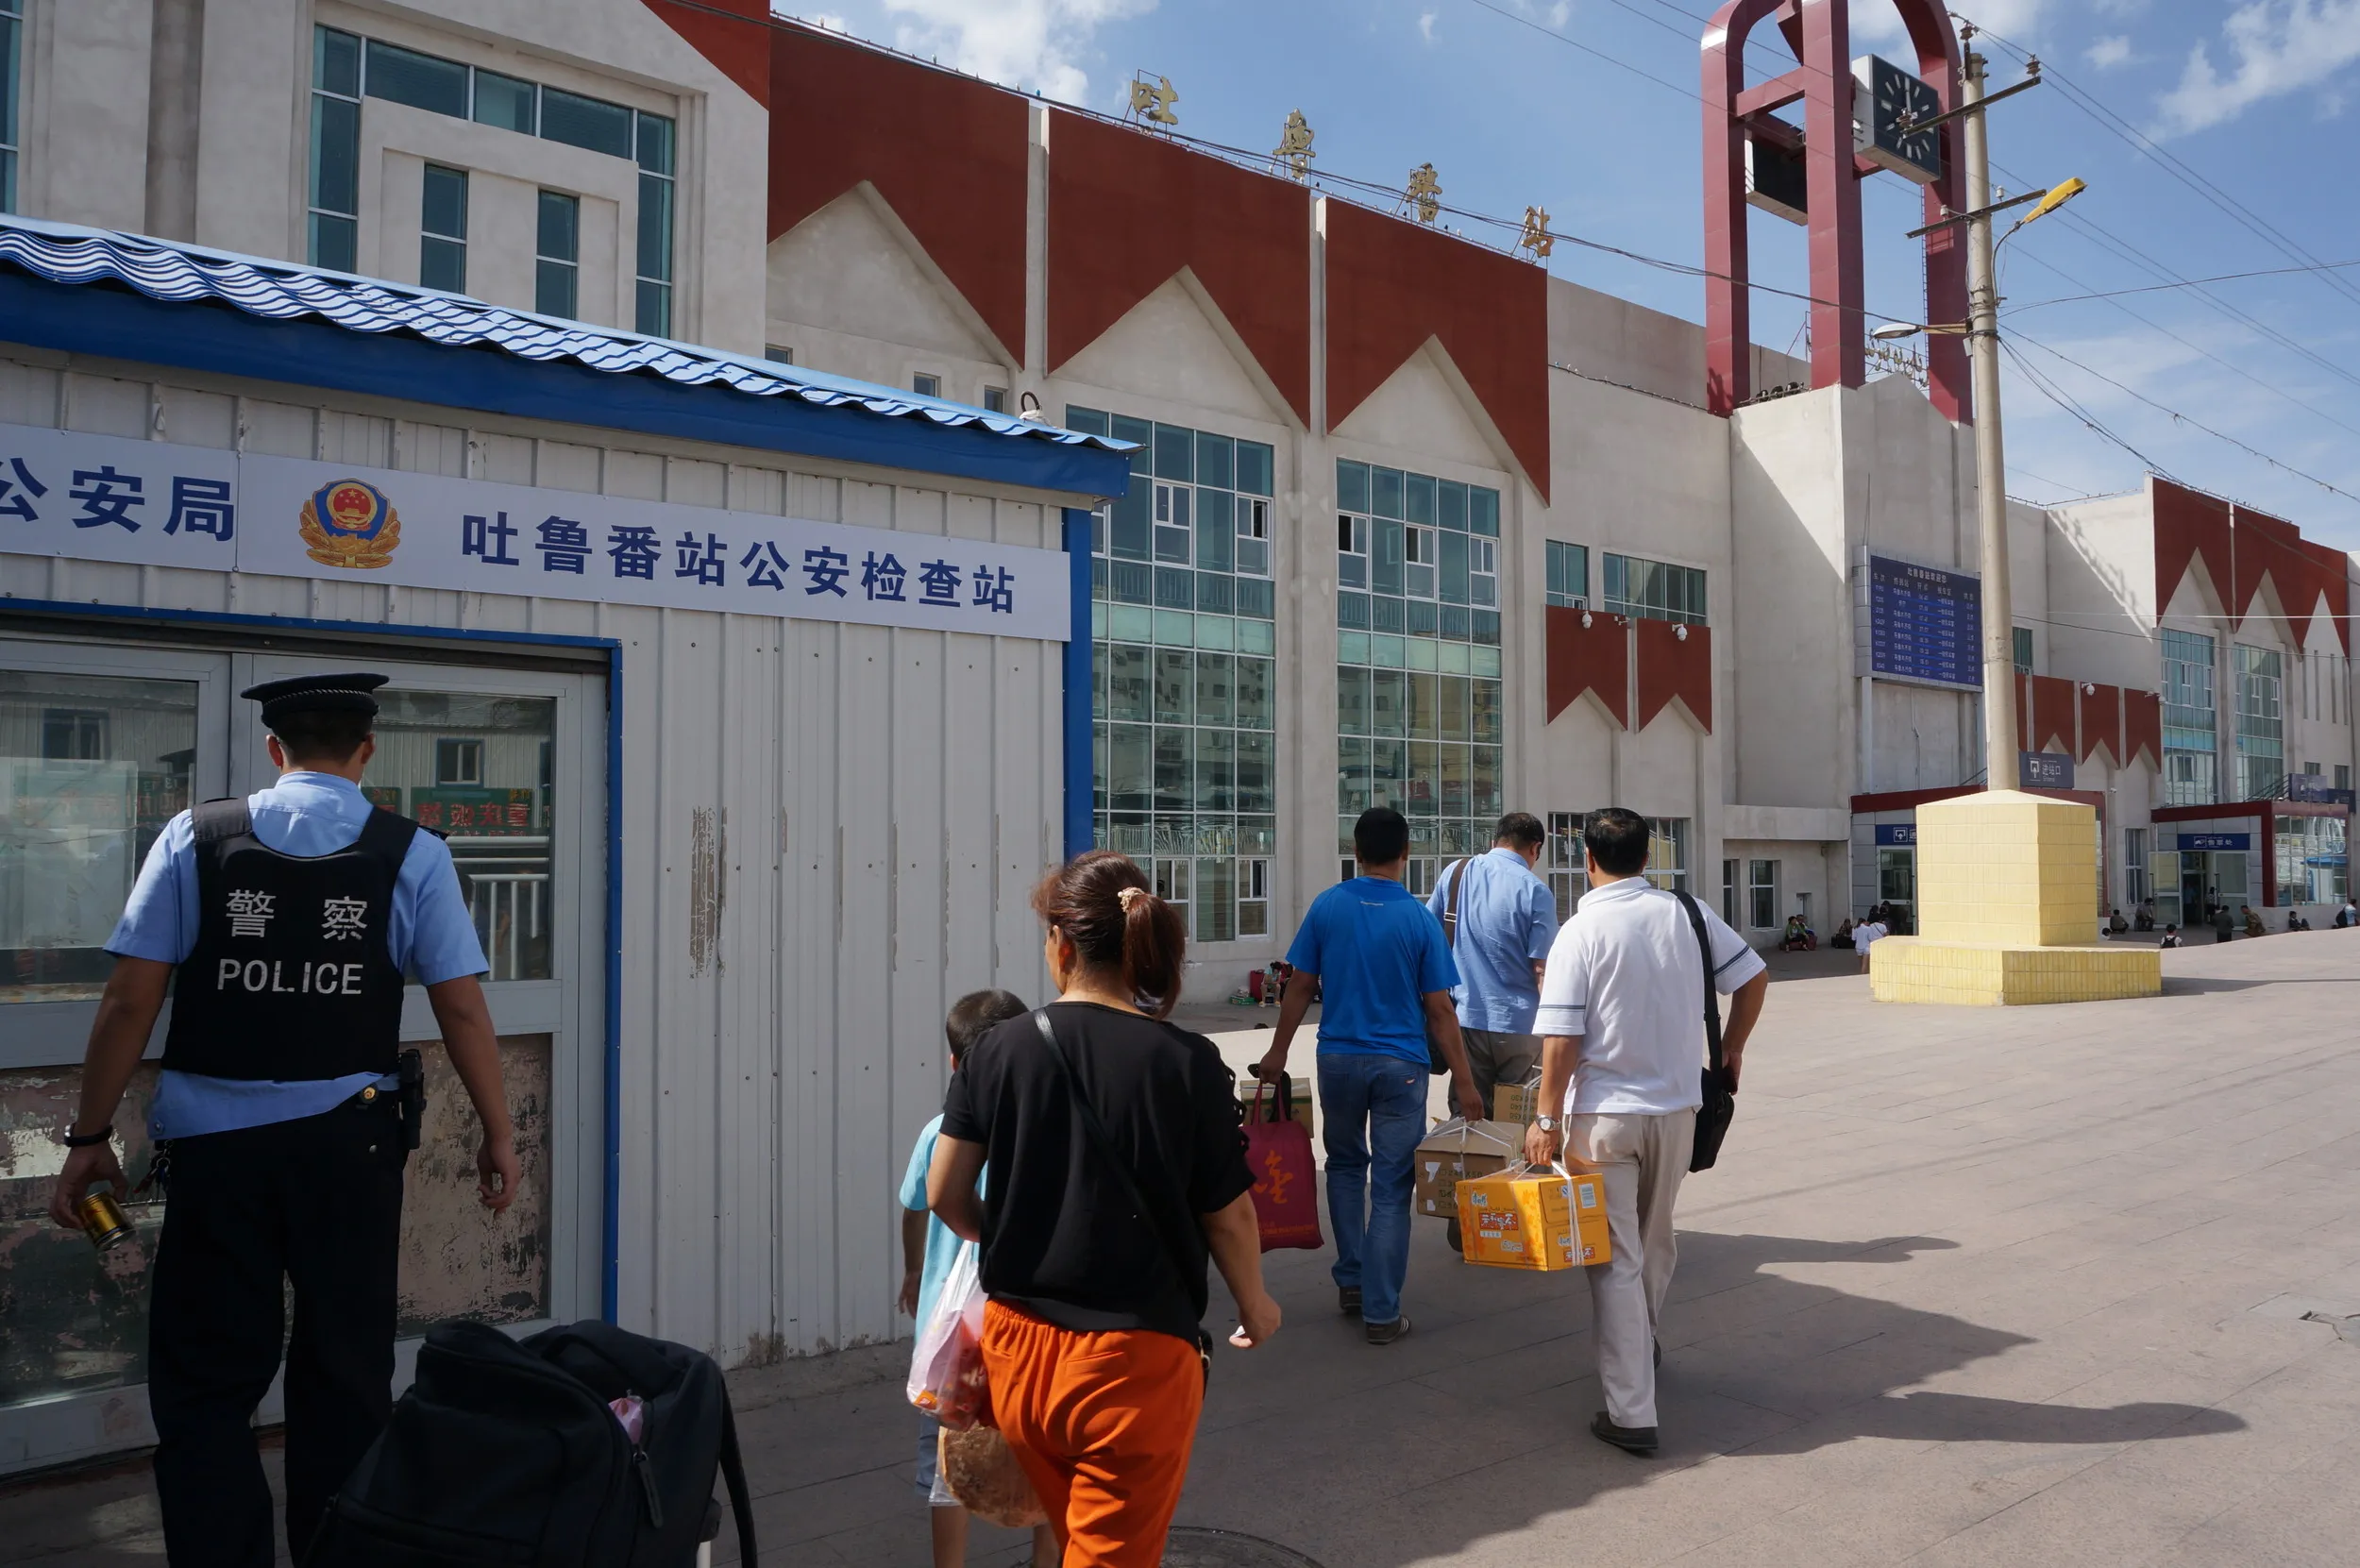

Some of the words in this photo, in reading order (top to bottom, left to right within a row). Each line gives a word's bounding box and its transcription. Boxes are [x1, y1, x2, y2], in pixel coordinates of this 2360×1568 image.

[0, 457, 234, 542] 公安局
[461, 511, 1016, 615] 吐鲁番站公安检查站
[2043, 764, 2061, 776] 进站口
[225, 888, 369, 941] 警察
[217, 958, 363, 995] POLICE
